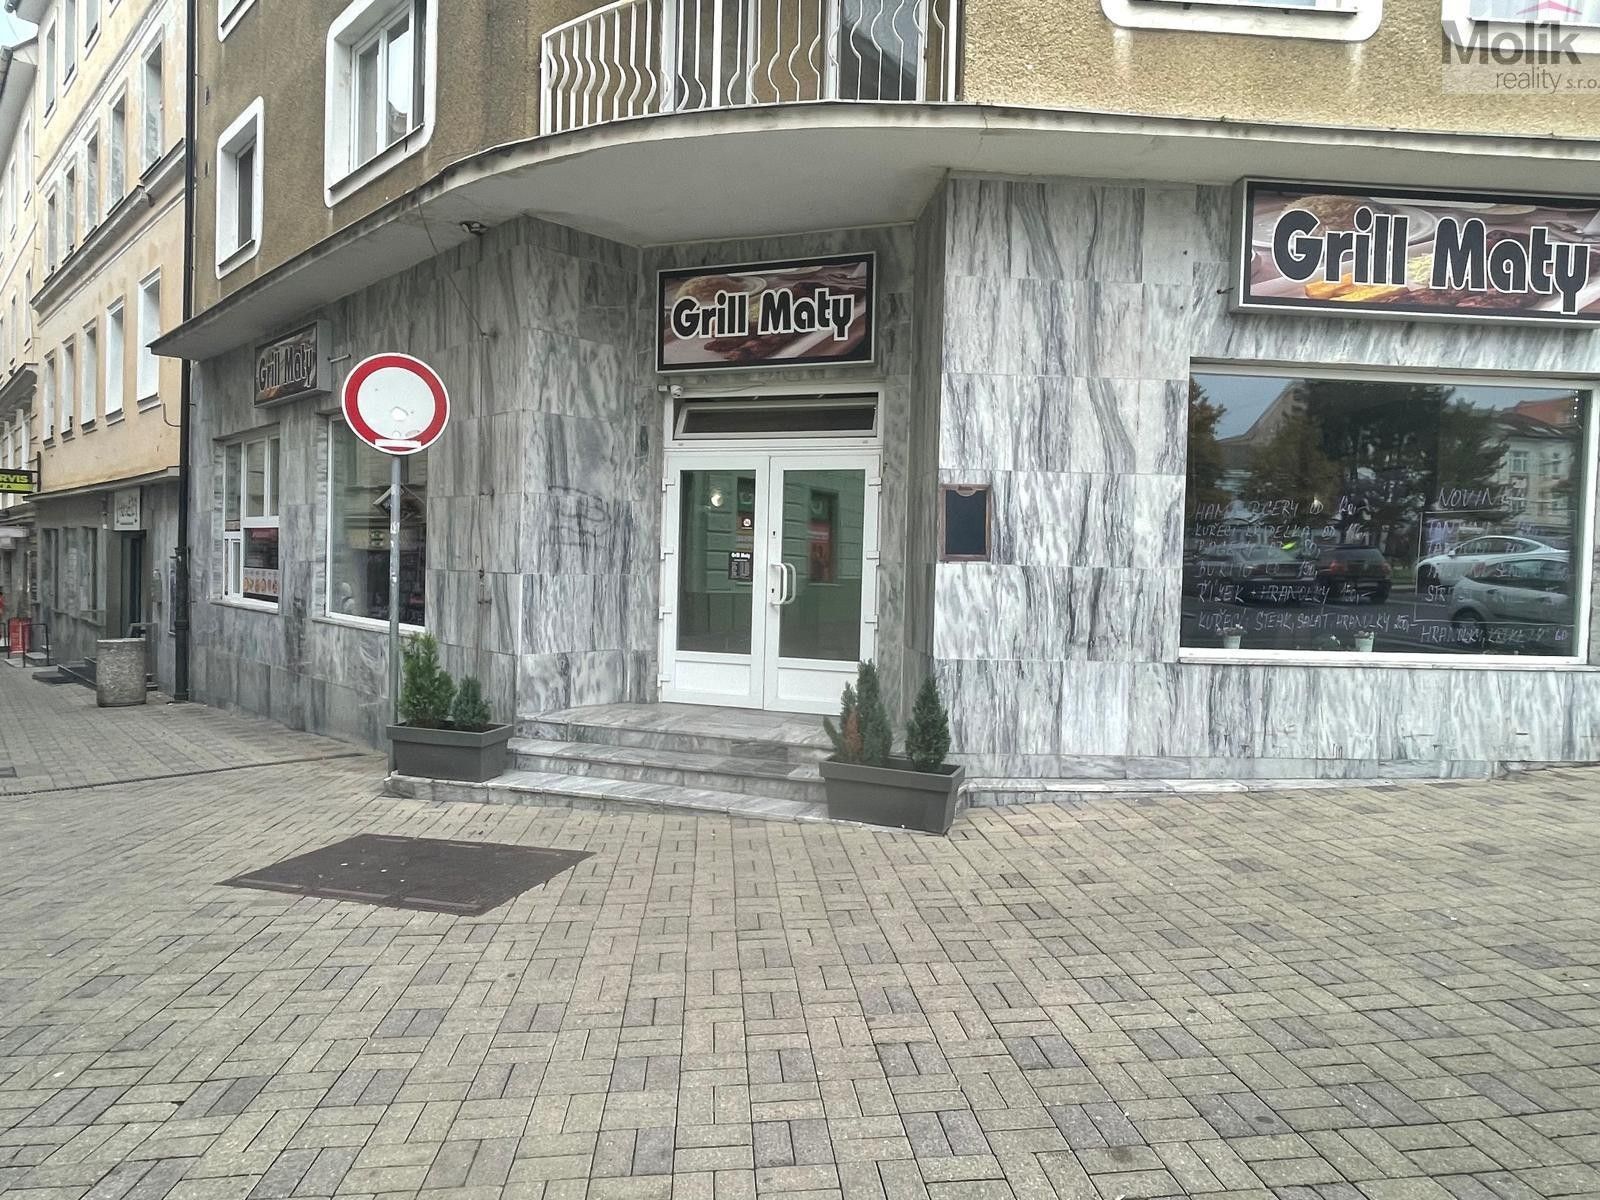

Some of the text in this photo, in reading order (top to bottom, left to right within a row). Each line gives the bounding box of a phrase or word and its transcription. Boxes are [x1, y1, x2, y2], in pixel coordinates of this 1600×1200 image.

[1271, 206, 1590, 315] Grill Maty
[671, 288, 855, 341] Grill Maty
[258, 343, 313, 392] Grill Maty
